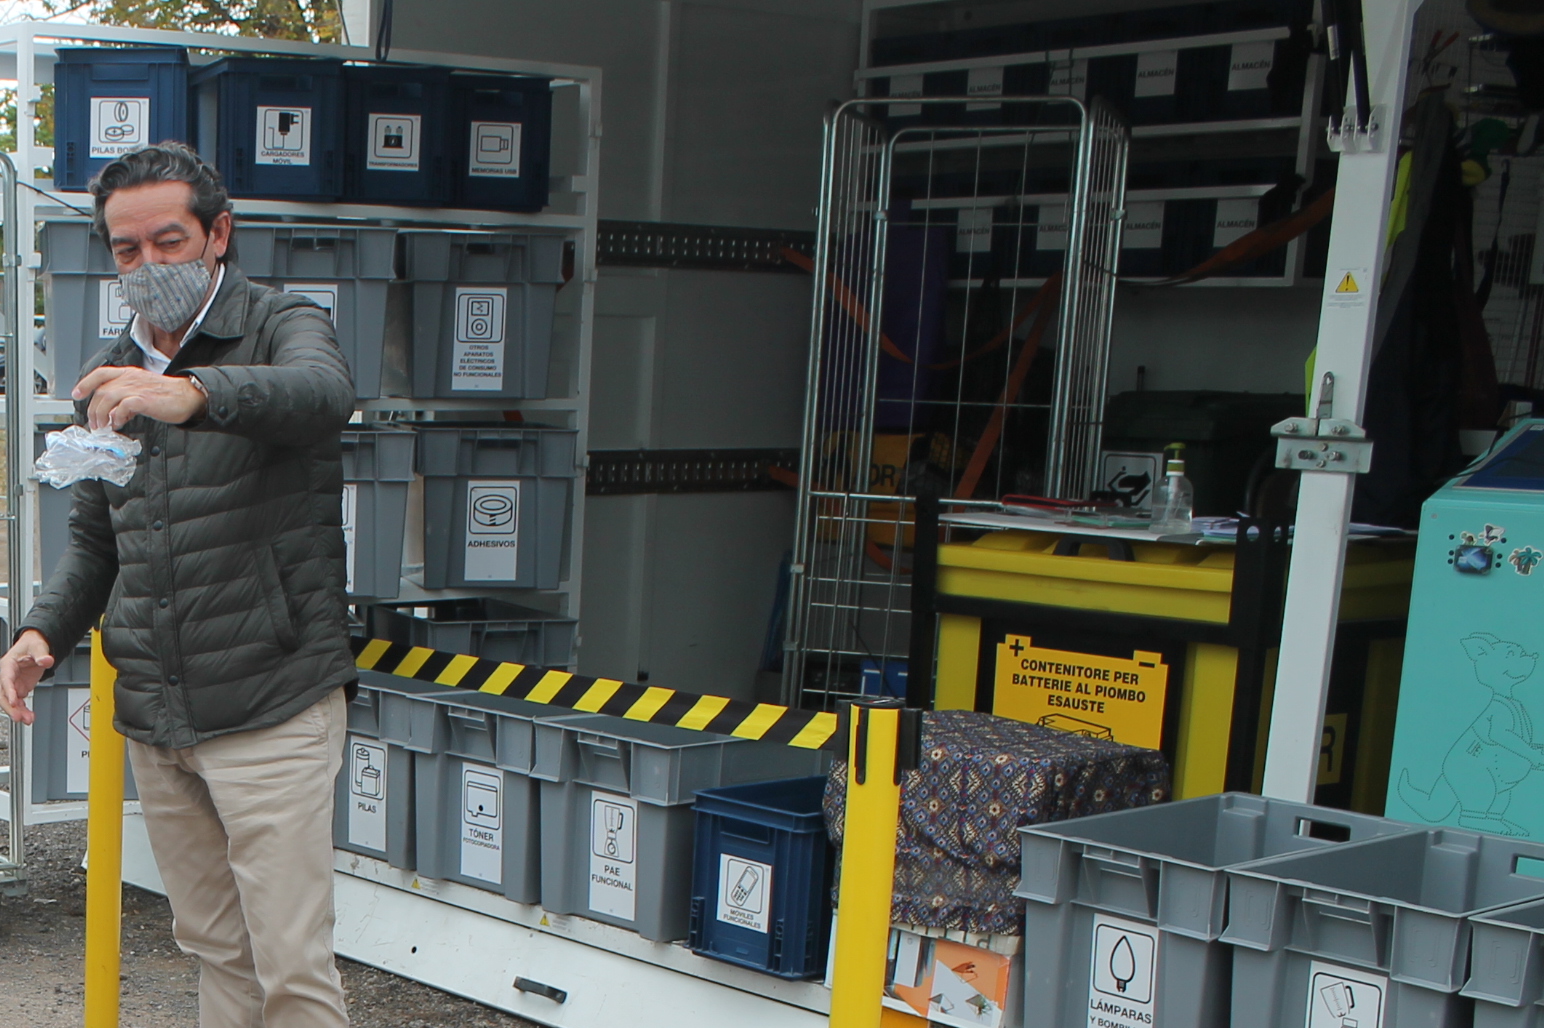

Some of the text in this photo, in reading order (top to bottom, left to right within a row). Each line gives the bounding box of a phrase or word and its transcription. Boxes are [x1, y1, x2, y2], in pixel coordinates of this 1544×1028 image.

[1232, 60, 1271, 70] ALMACÉN
[1138, 69, 1174, 78] ALMACÉN
[260, 150, 305, 158] CARGADORES
[1126, 221, 1160, 229] ALMACÉN
[1217, 220, 1254, 228] ALMACÉN
[467, 540, 515, 548] ADHESIVOS
[1021, 659, 1139, 685] CONTENITORE PER
[1012, 673, 1146, 703] BATTERIE AL PIOMBO
[1047, 694, 1105, 713] ESAUSTE
[357, 802, 377, 814] PILAS
[469, 828, 494, 842] TÓNER
[463, 837, 500, 851] FOTOCOPIADORA
[604, 865, 620, 877] PAE
[591, 874, 633, 891] FUNCIONAL
[723, 914, 761, 929] FUNCIONALES
[1090, 998, 1152, 1024] LÁMPARAS
[1090, 1015, 1096, 1024] Y
